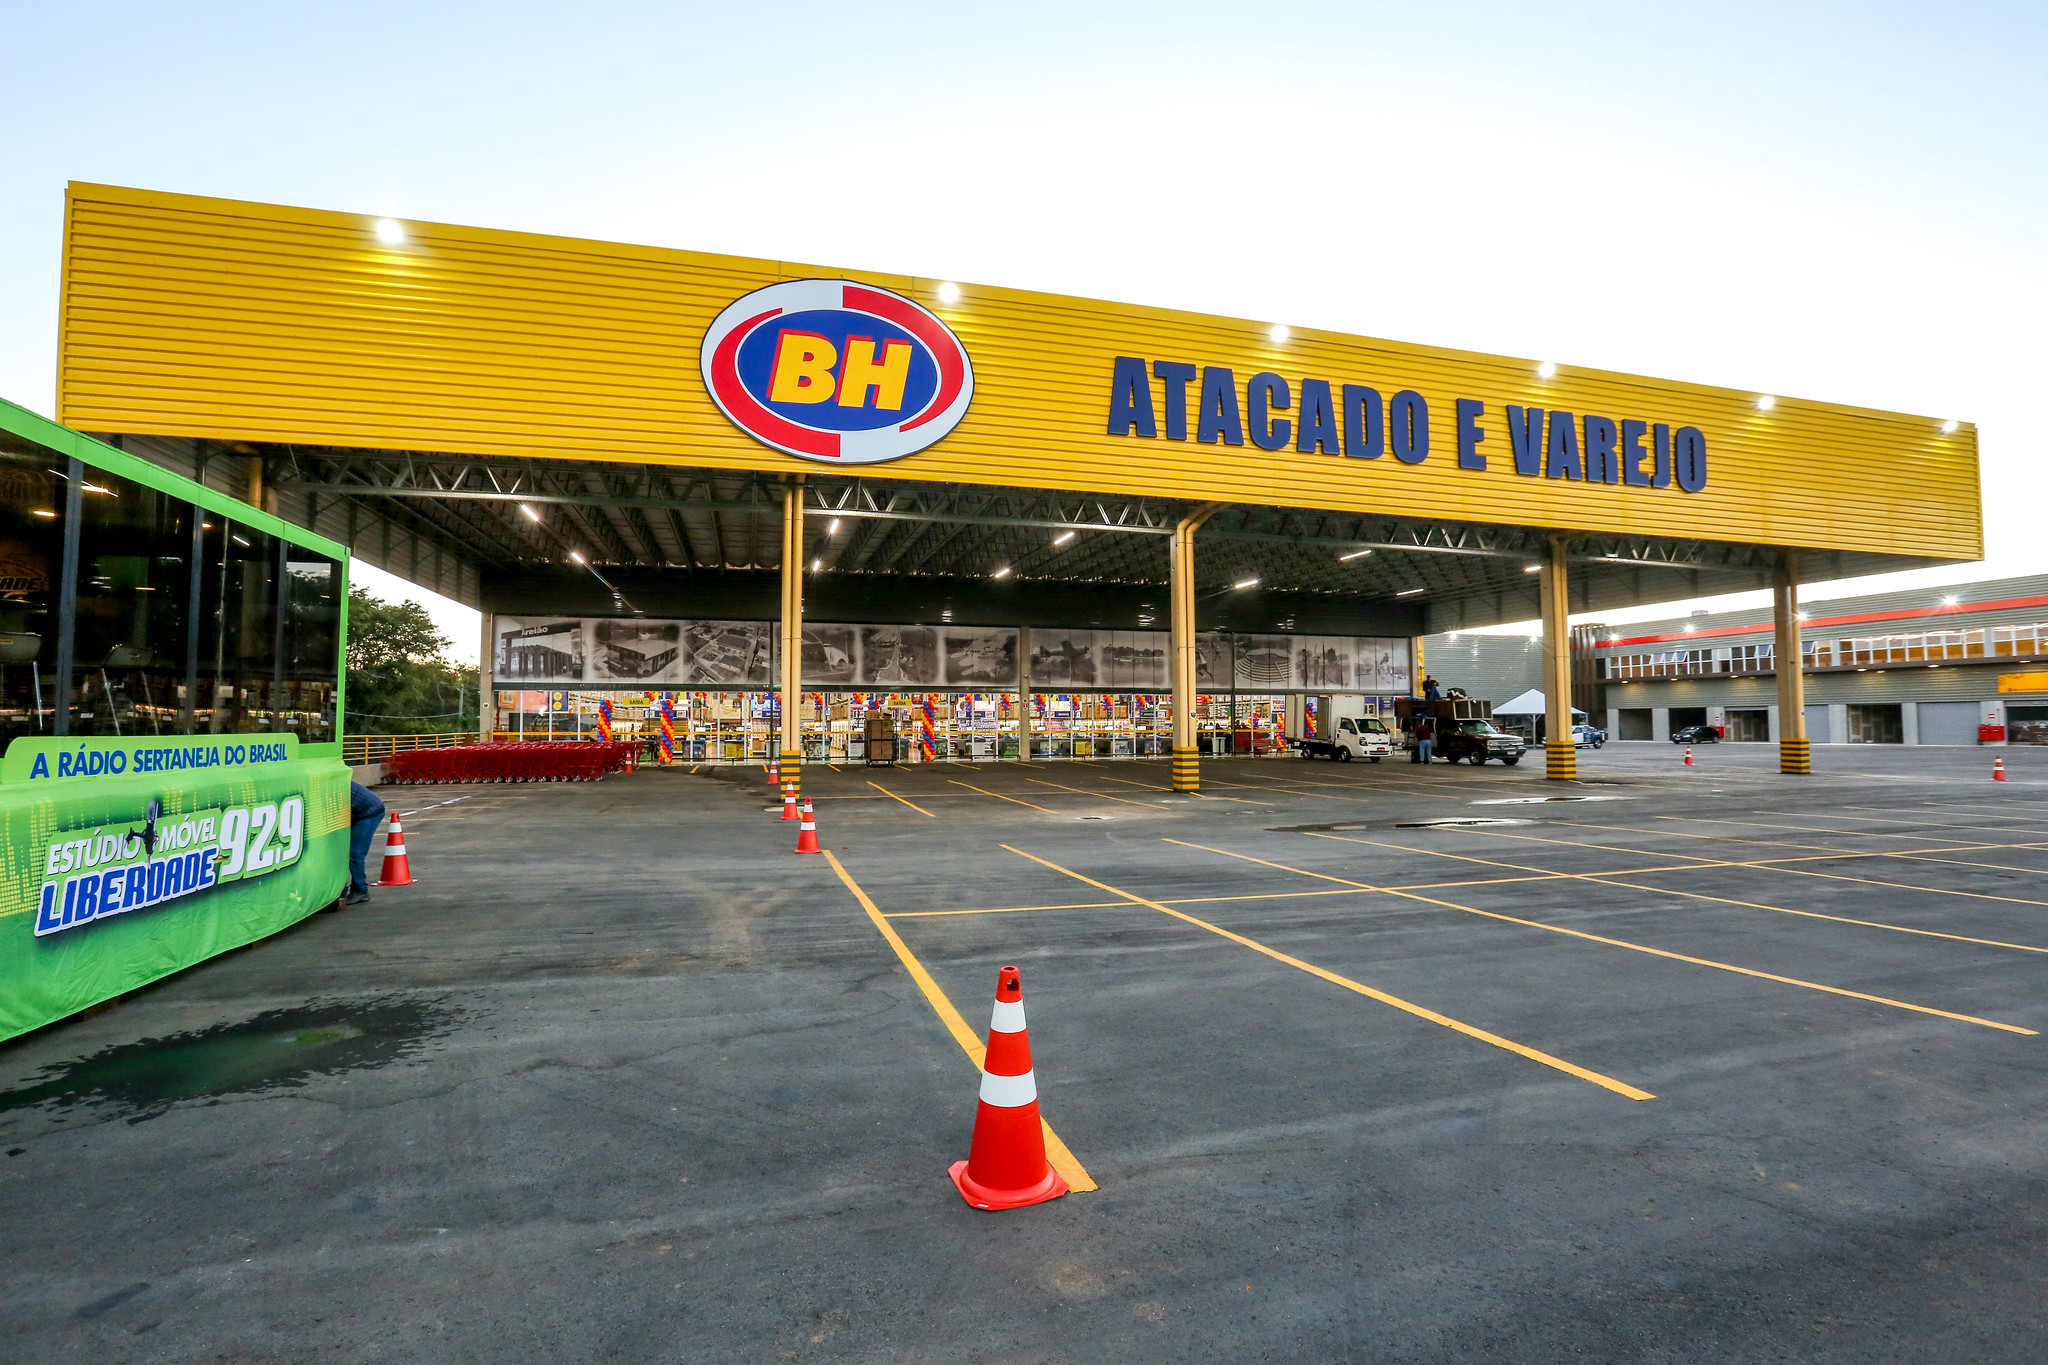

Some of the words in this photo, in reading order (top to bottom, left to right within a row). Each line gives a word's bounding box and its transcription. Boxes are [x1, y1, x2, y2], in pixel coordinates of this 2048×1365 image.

[766, 328, 913, 411] BH
[1108, 356, 1429, 465] ATACADO
[1457, 398, 1487, 471] E
[1507, 404, 1707, 493] VAREJO
[29, 752, 50, 779] A
[58, 743, 127, 778] RÁDIO
[133, 747, 220, 773] SERTANEJA
[225, 745, 246, 766] DO
[250, 743, 288, 762] BRASIL
[47, 828, 142, 875] ESTÚDIO
[159, 815, 217, 853] MÓVEL
[36, 847, 218, 933] LIBERDADE
